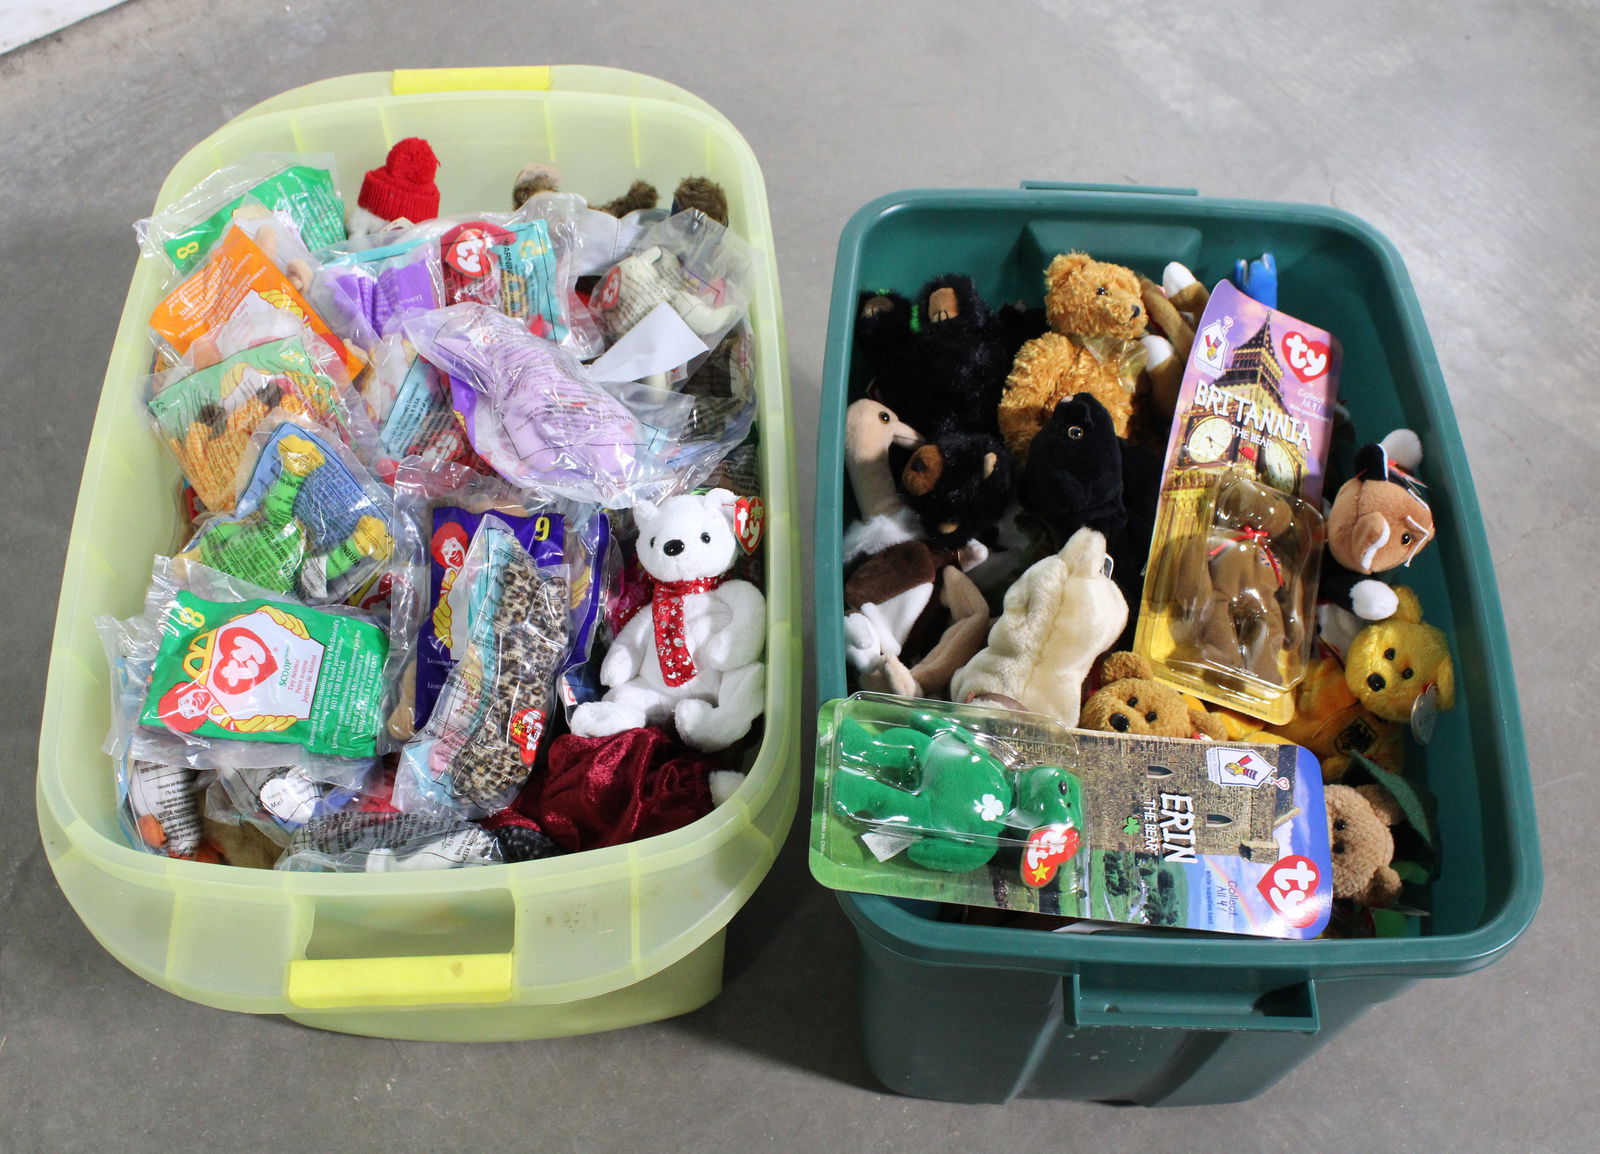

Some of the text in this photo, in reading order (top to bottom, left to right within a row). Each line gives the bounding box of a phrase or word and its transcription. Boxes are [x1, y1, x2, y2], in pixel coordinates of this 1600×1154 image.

[455, 236, 482, 275] ty
[1285, 334, 1327, 377] ty
[1193, 379, 1313, 451] BRITANNIA
[1231, 424, 1273, 448] THE BEAR
[533, 516, 551, 542] 9
[737, 508, 762, 548] ty
[179, 606, 206, 628] 8
[220, 636, 267, 687] ty
[278, 658, 291, 687] SCOOP
[1143, 799, 1158, 851] THE BEAR
[1159, 792, 1198, 864] ERIN
[1227, 880, 1239, 916] Collect
[1270, 860, 1317, 920] ty
